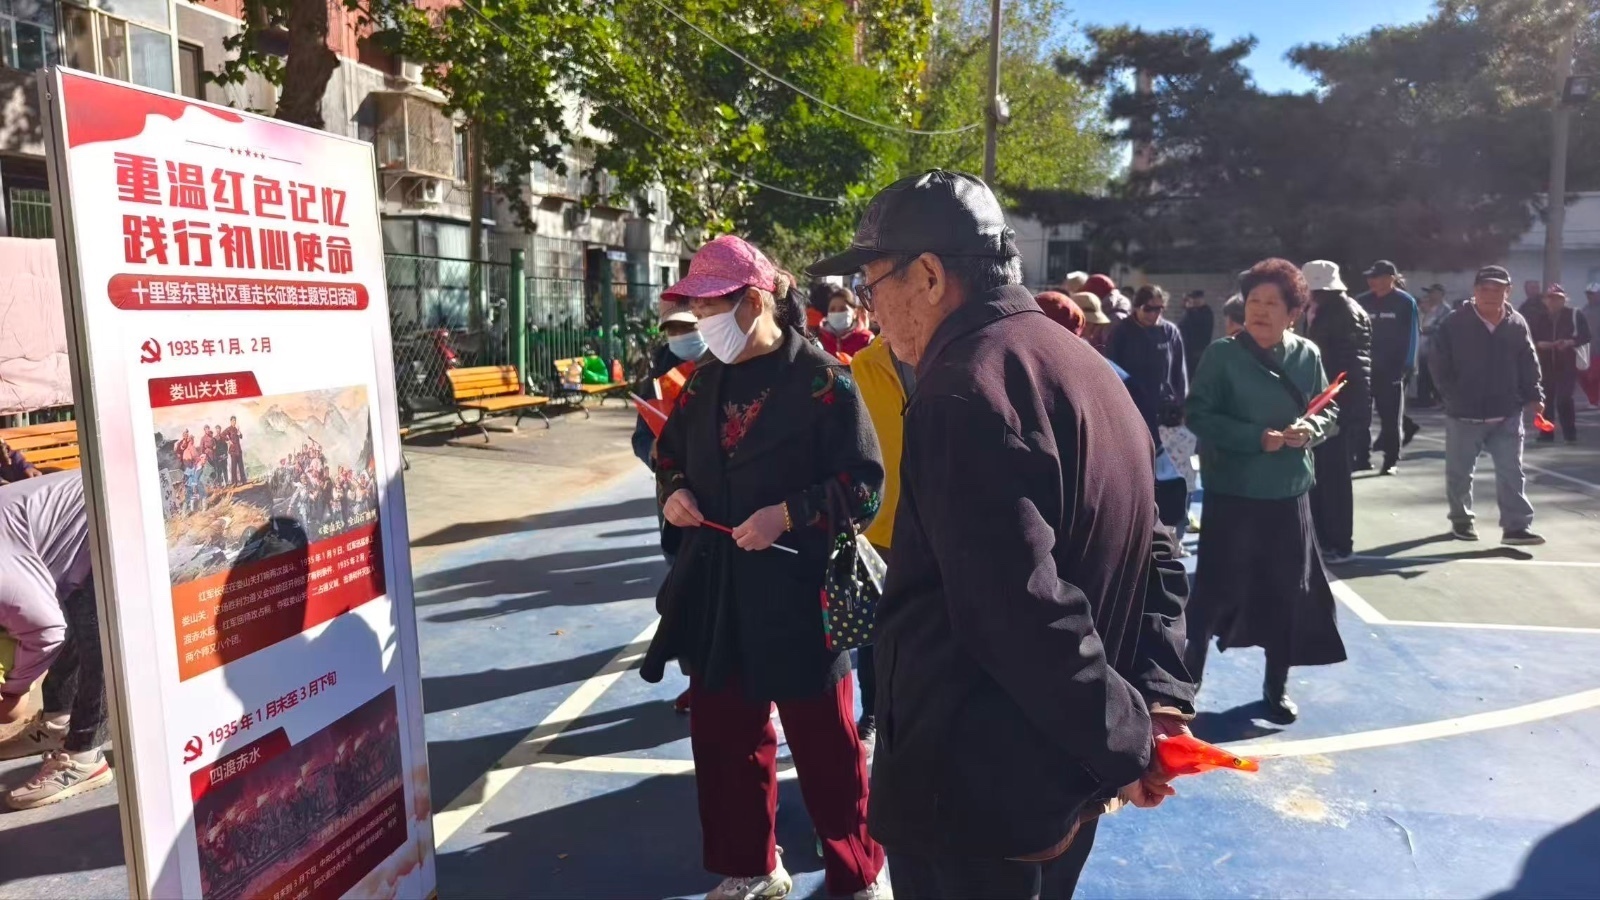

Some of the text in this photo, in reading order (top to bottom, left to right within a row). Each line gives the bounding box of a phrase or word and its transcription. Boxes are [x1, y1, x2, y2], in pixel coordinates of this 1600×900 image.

[113, 151, 350, 228] 重温红色记忆
[122, 213, 354, 275] 践行初心使命
[131, 280, 358, 306] 十里堡东里社区重走长征路主题党日活动
[169, 378, 238, 402] 娄山关大捷
[209, 746, 262, 786] 四渡赤水
